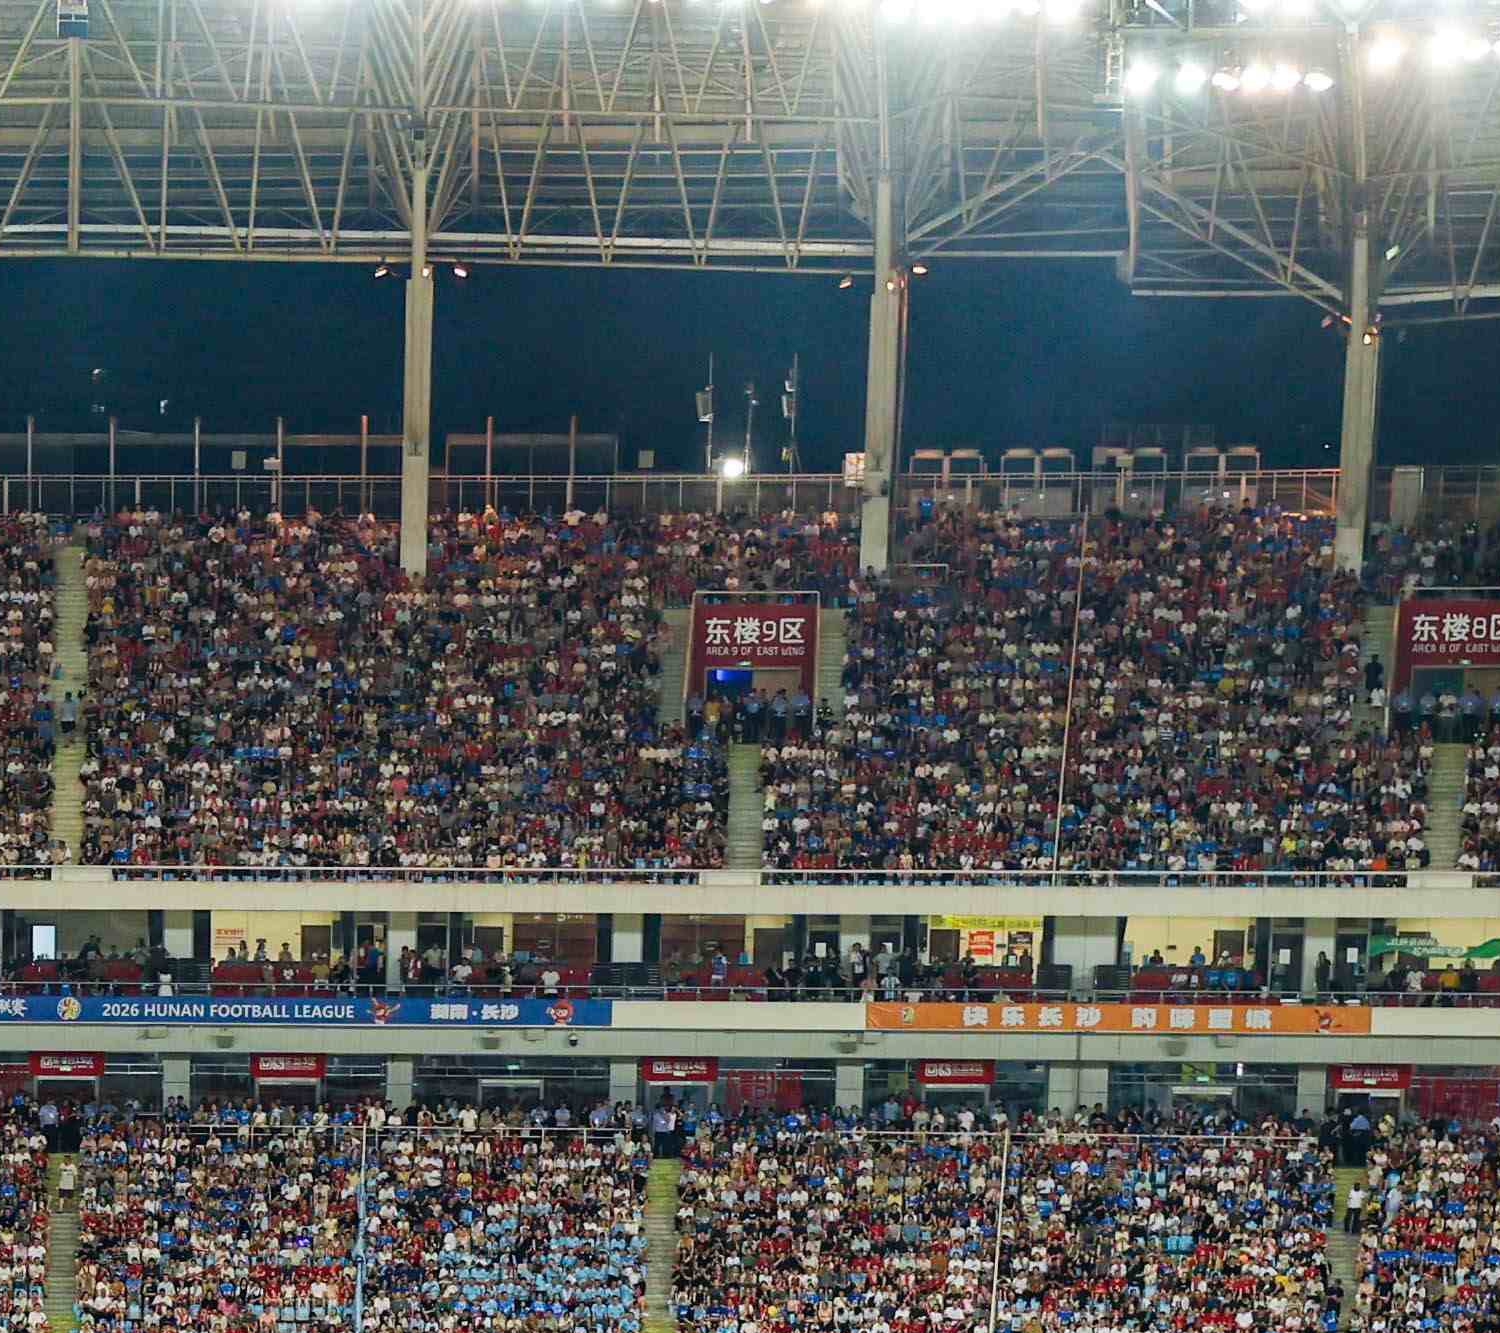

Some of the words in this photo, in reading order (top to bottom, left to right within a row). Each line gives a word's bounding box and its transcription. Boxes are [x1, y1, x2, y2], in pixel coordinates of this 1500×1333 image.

[705, 617, 805, 644] 东楼9区
[706, 646, 729, 656] AREA
[731, 647, 738, 656] 9
[741, 646, 753, 655] OF
[757, 646, 778, 655] EAST
[781, 647, 805, 656] WING
[103, 1004, 139, 1016] 2026
[145, 1004, 204, 1016] HUNAN
[210, 1004, 289, 1017] FOOTBALL
[295, 1005, 354, 1018] LEAGUE
